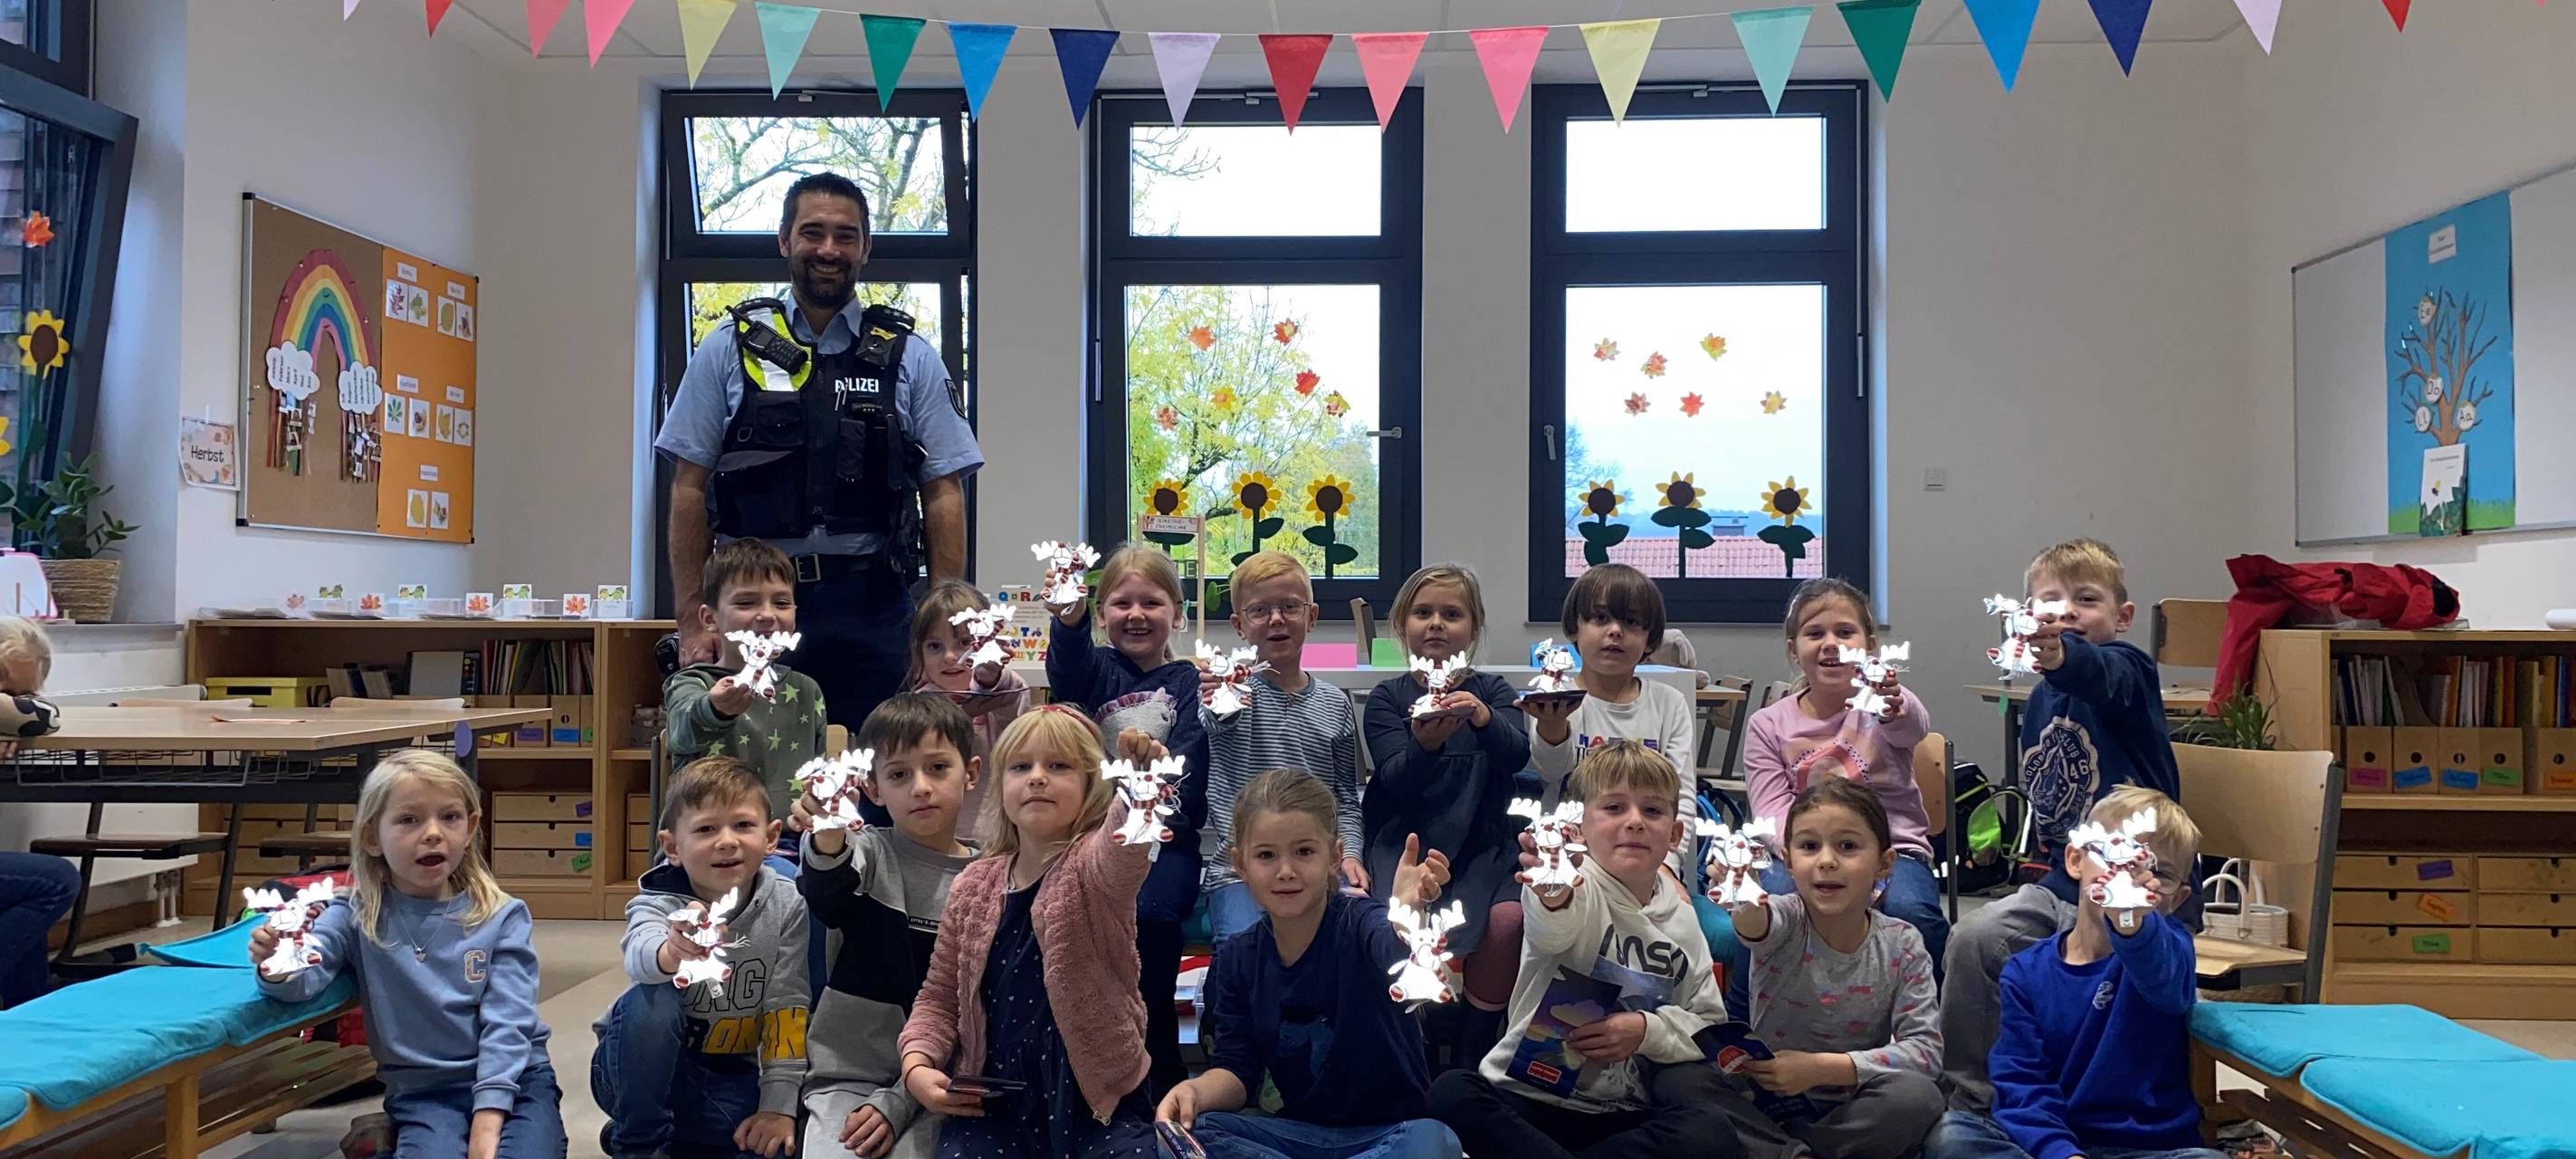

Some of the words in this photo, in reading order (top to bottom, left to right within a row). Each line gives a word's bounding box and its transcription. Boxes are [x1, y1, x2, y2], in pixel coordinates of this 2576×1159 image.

[191, 445, 224, 463] Herbst
[2070, 759, 2089, 779] 46
[463, 949, 487, 983] C
